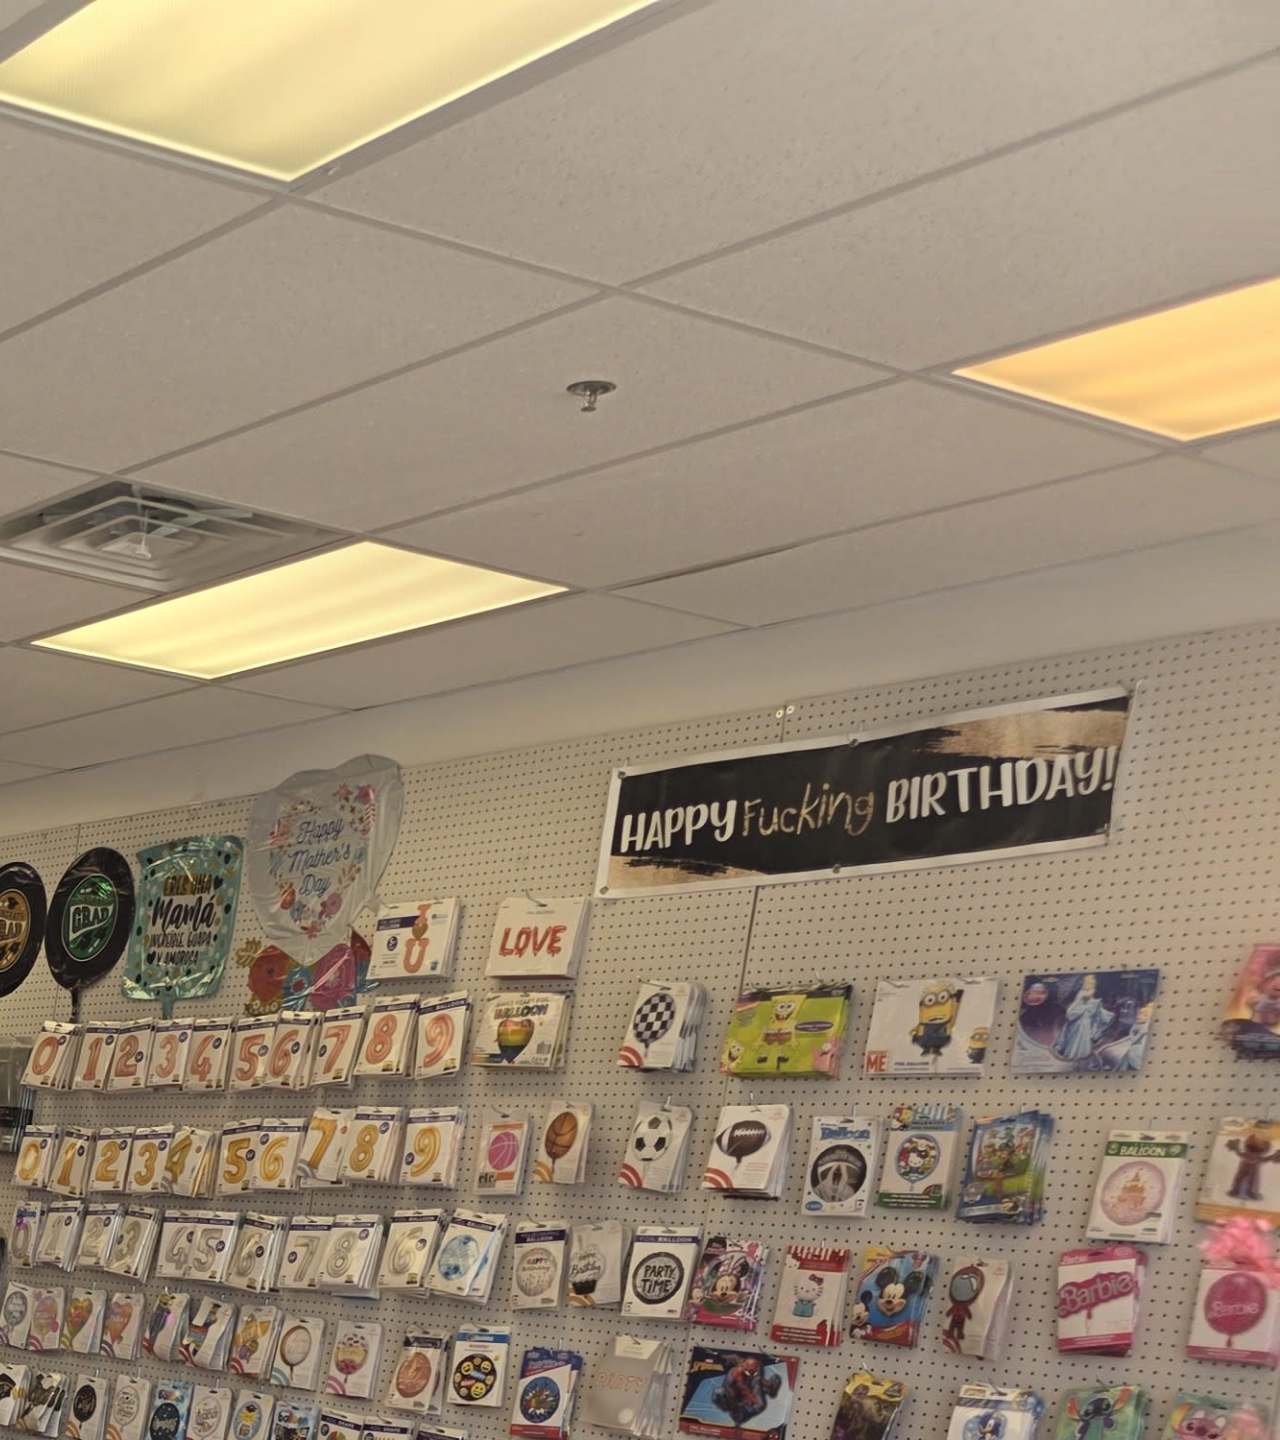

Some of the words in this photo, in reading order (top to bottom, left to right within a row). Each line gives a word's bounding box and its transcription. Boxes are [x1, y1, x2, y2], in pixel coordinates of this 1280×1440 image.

[621, 800, 737, 853] HAPPY
[742, 783, 873, 836] Fucking
[886, 746, 1118, 824] BIRTHDAY!
[297, 818, 345, 844] Happy
[288, 845, 351, 872] Mother's
[299, 874, 331, 897] Day
[72, 907, 110, 933] GRAD
[152, 895, 216, 932] Mamá
[498, 925, 567, 958] LOVE
[365, 1013, 397, 1065] 8
[424, 1013, 454, 1067] 9
[641, 1279, 673, 1294] TIME
[644, 1265, 676, 1278] PARTY
[1059, 1273, 1135, 1312] Barbie
